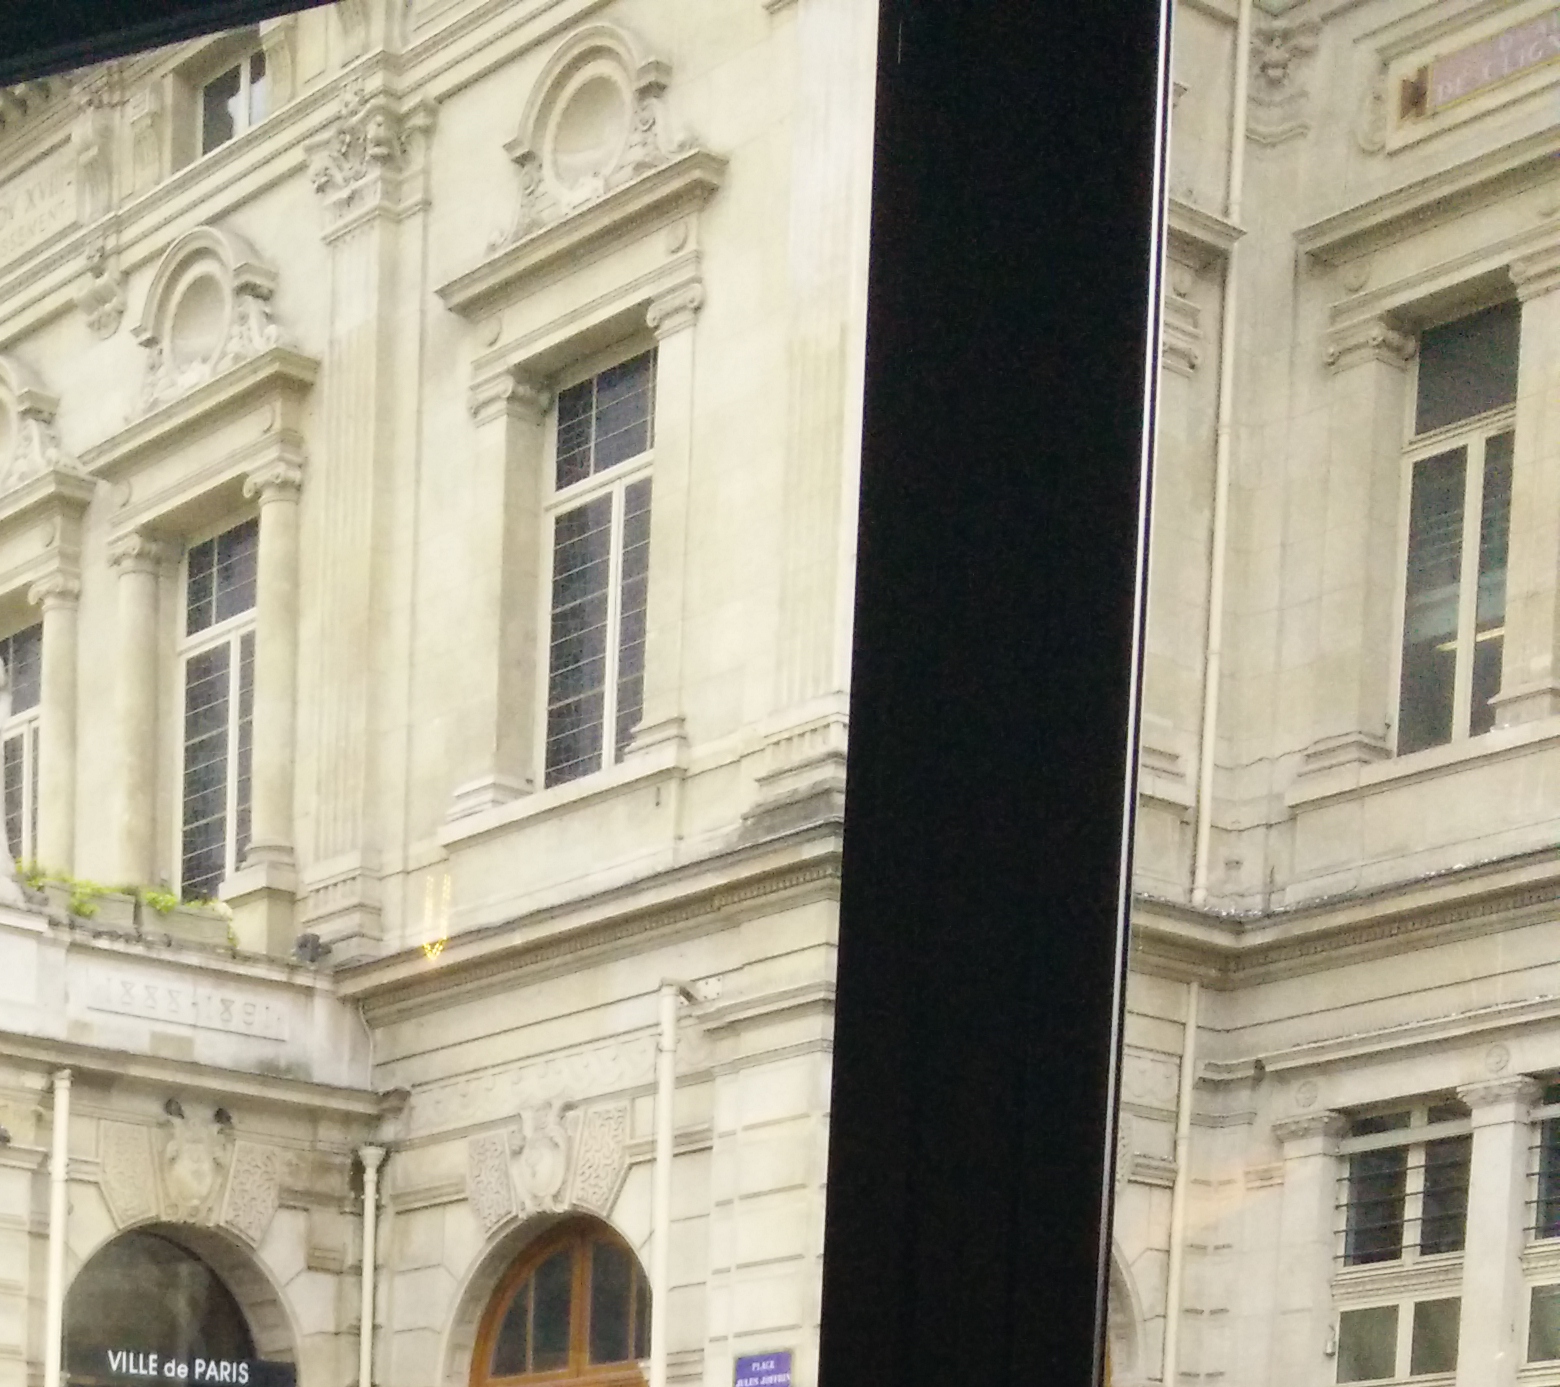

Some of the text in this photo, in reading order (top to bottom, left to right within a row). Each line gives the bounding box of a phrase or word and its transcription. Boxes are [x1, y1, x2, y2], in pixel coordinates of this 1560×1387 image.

[107, 1349, 249, 1384] VILLE de PARIS
